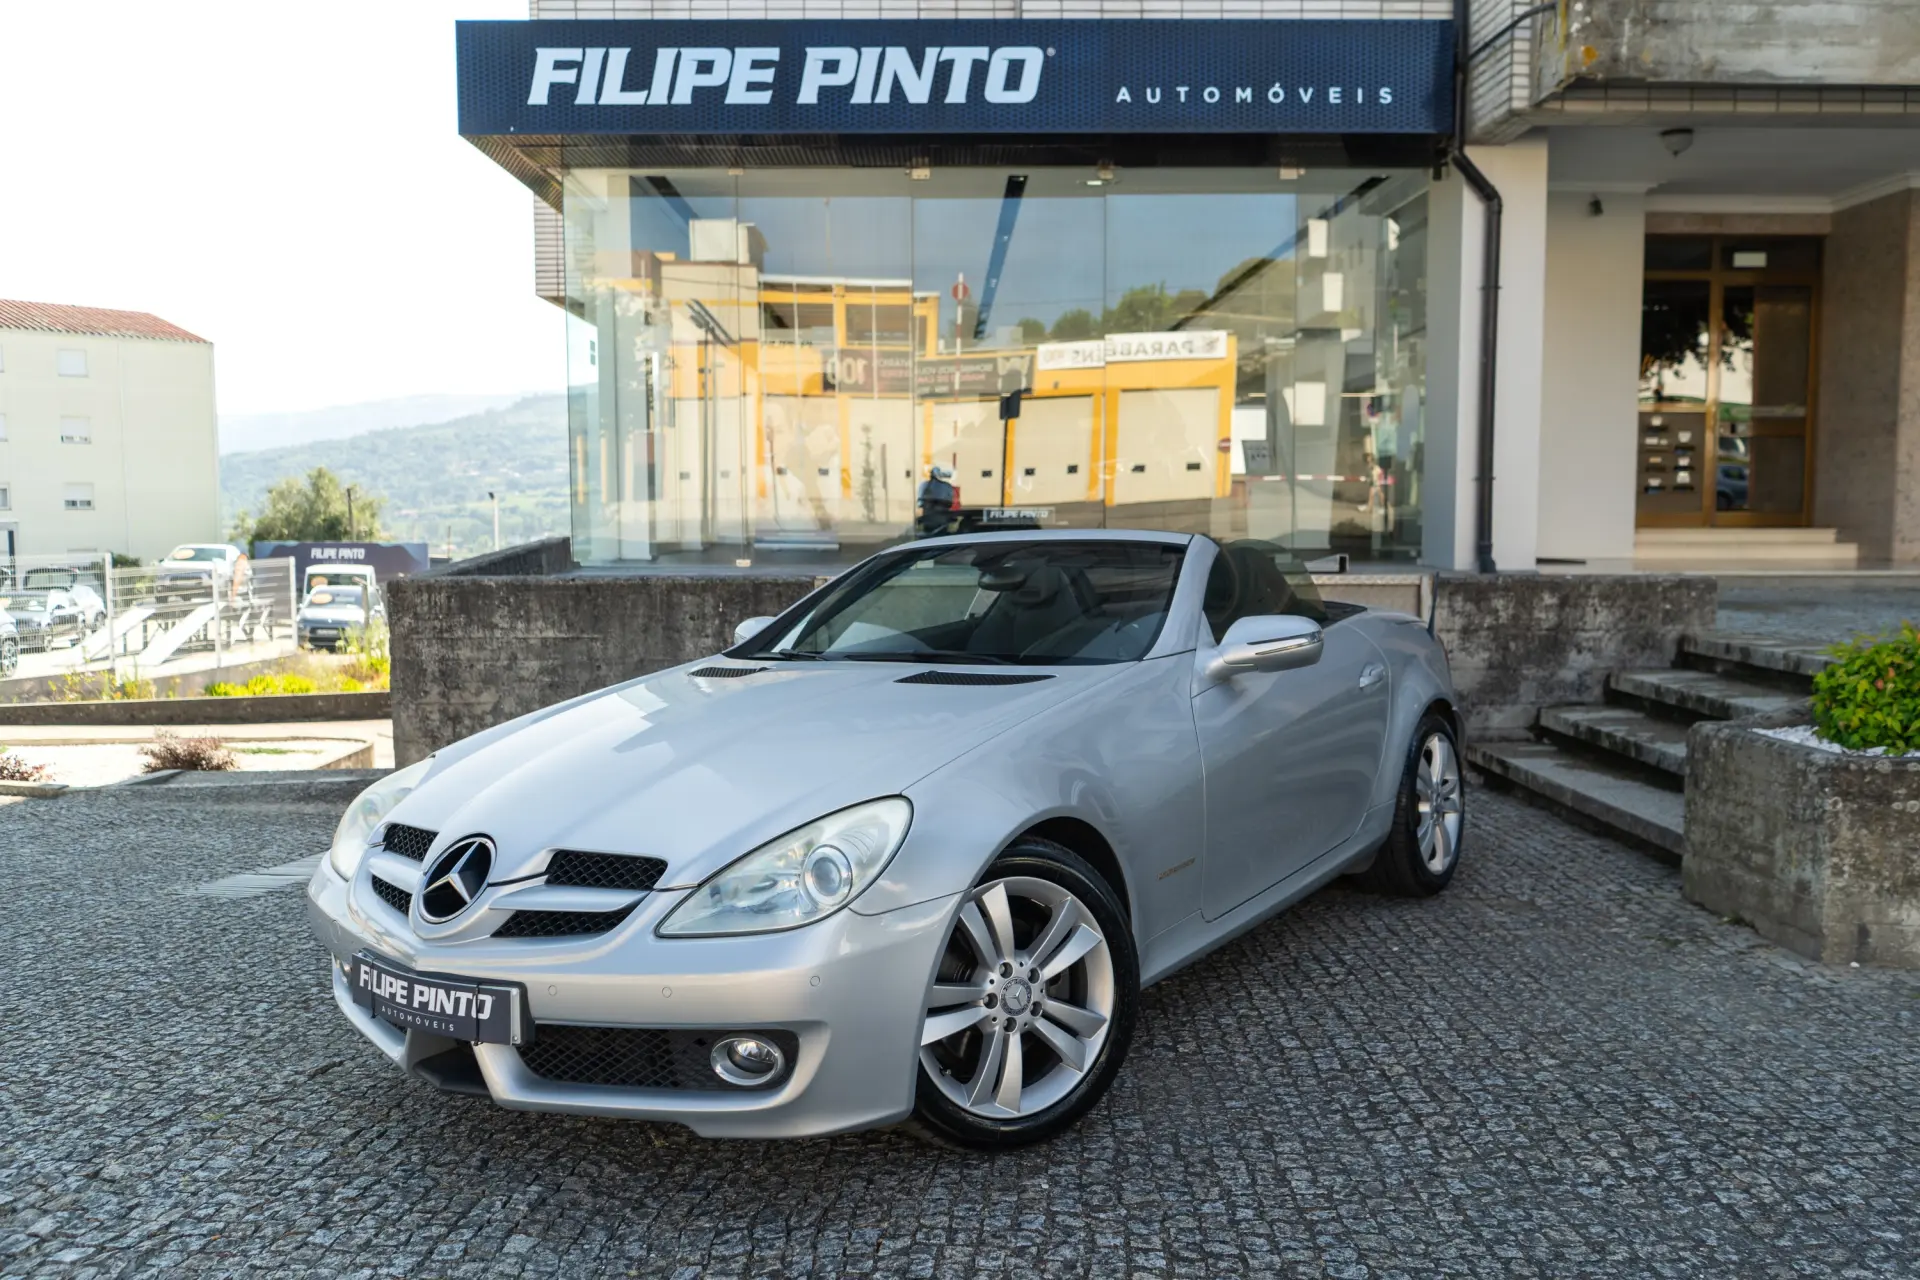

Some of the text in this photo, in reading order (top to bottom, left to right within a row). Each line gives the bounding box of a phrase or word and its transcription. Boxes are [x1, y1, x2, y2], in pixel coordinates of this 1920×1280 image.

[527, 46, 1044, 106] FILIPE PINTO
[1115, 82, 1393, 104] AUTOMÓVEIS
[311, 548, 365, 559] FILIPE PINTO
[359, 964, 494, 1020] FILIPE PINTO
[381, 1005, 454, 1032] AUTOMÓVEIS
